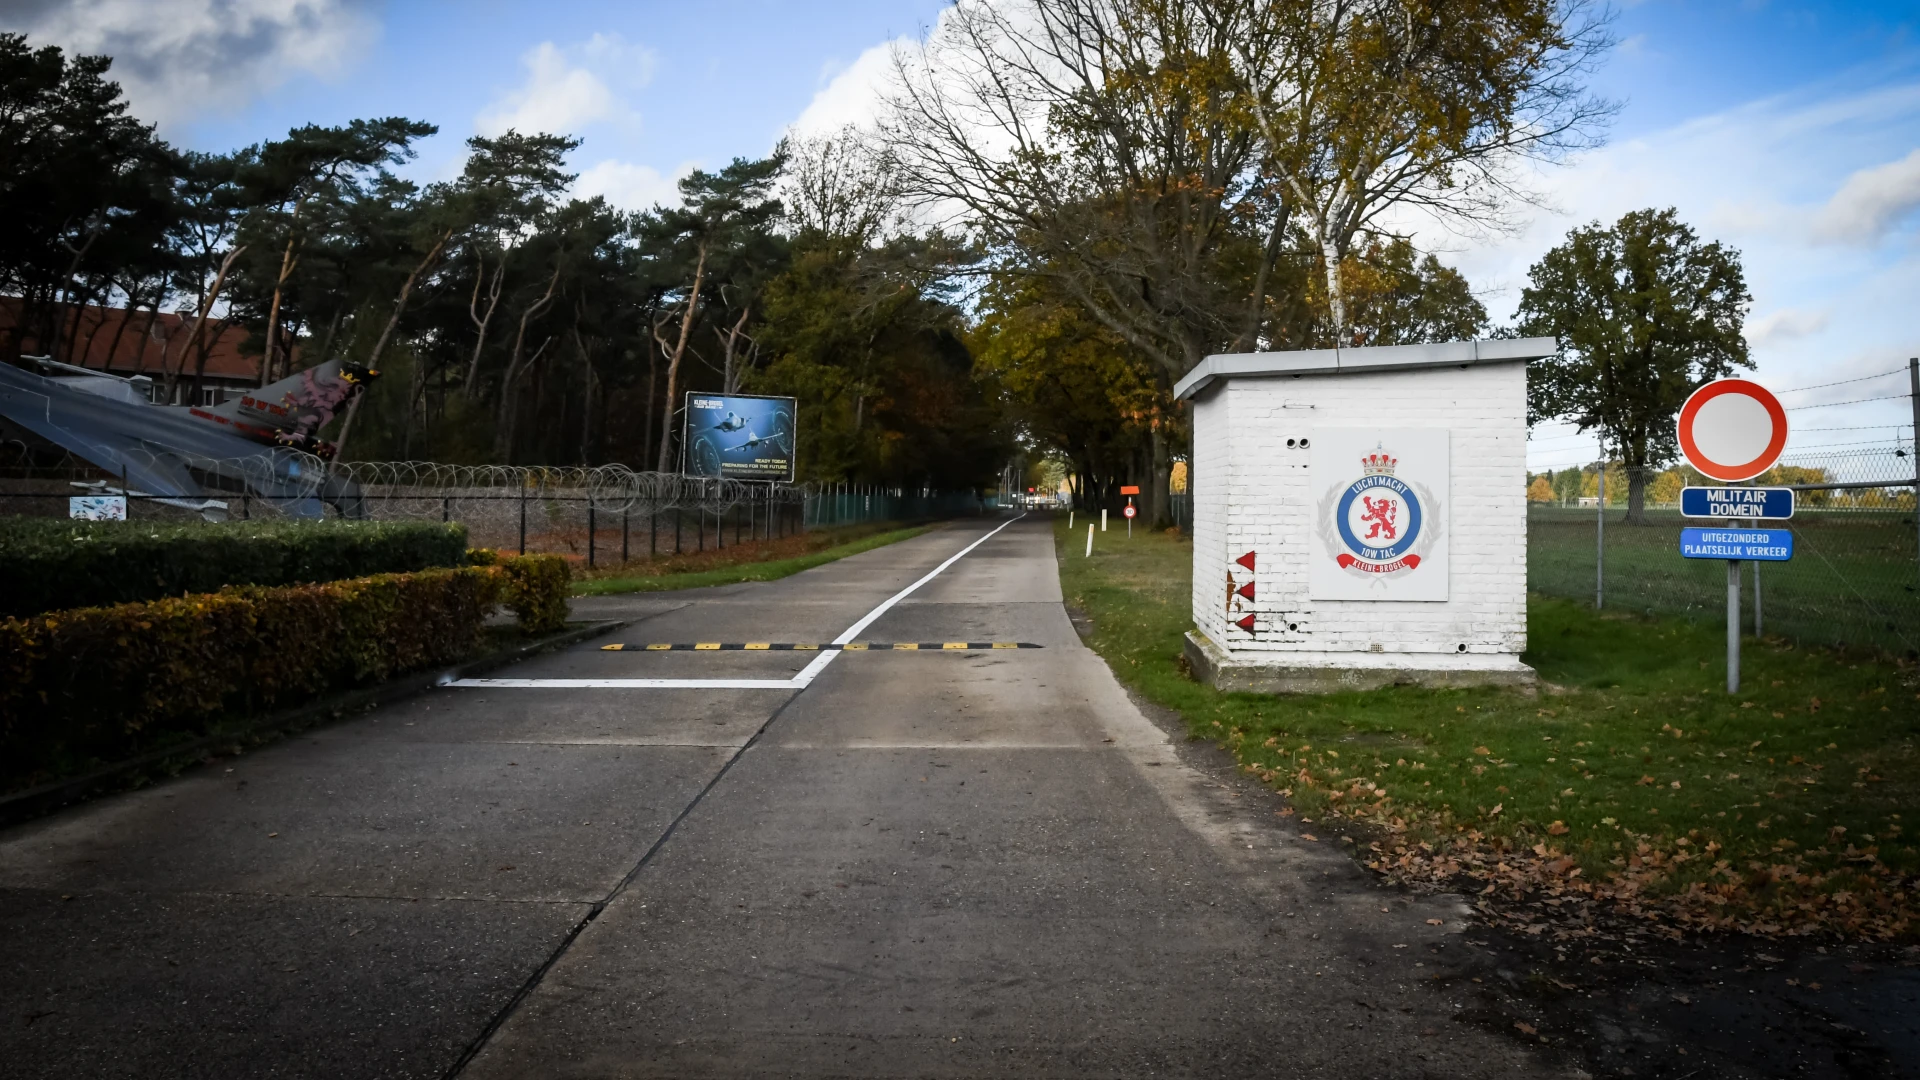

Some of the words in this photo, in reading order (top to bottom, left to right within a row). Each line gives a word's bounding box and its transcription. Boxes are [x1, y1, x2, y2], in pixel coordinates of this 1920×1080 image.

[1352, 477, 1408, 494] LUCHTMACHT
[1707, 490, 1766, 502] MILITAIR
[1710, 503, 1762, 516] DOMEIN
[1702, 533, 1769, 543] UITGEZONDERD
[1361, 548, 1377, 559] 10W
[1380, 548, 1395, 559] TAC
[1685, 545, 1742, 555] PLAATSELIJK
[1746, 547, 1787, 556] VERKEER
[1352, 560, 1406, 572] KLEINE-BROGEL
